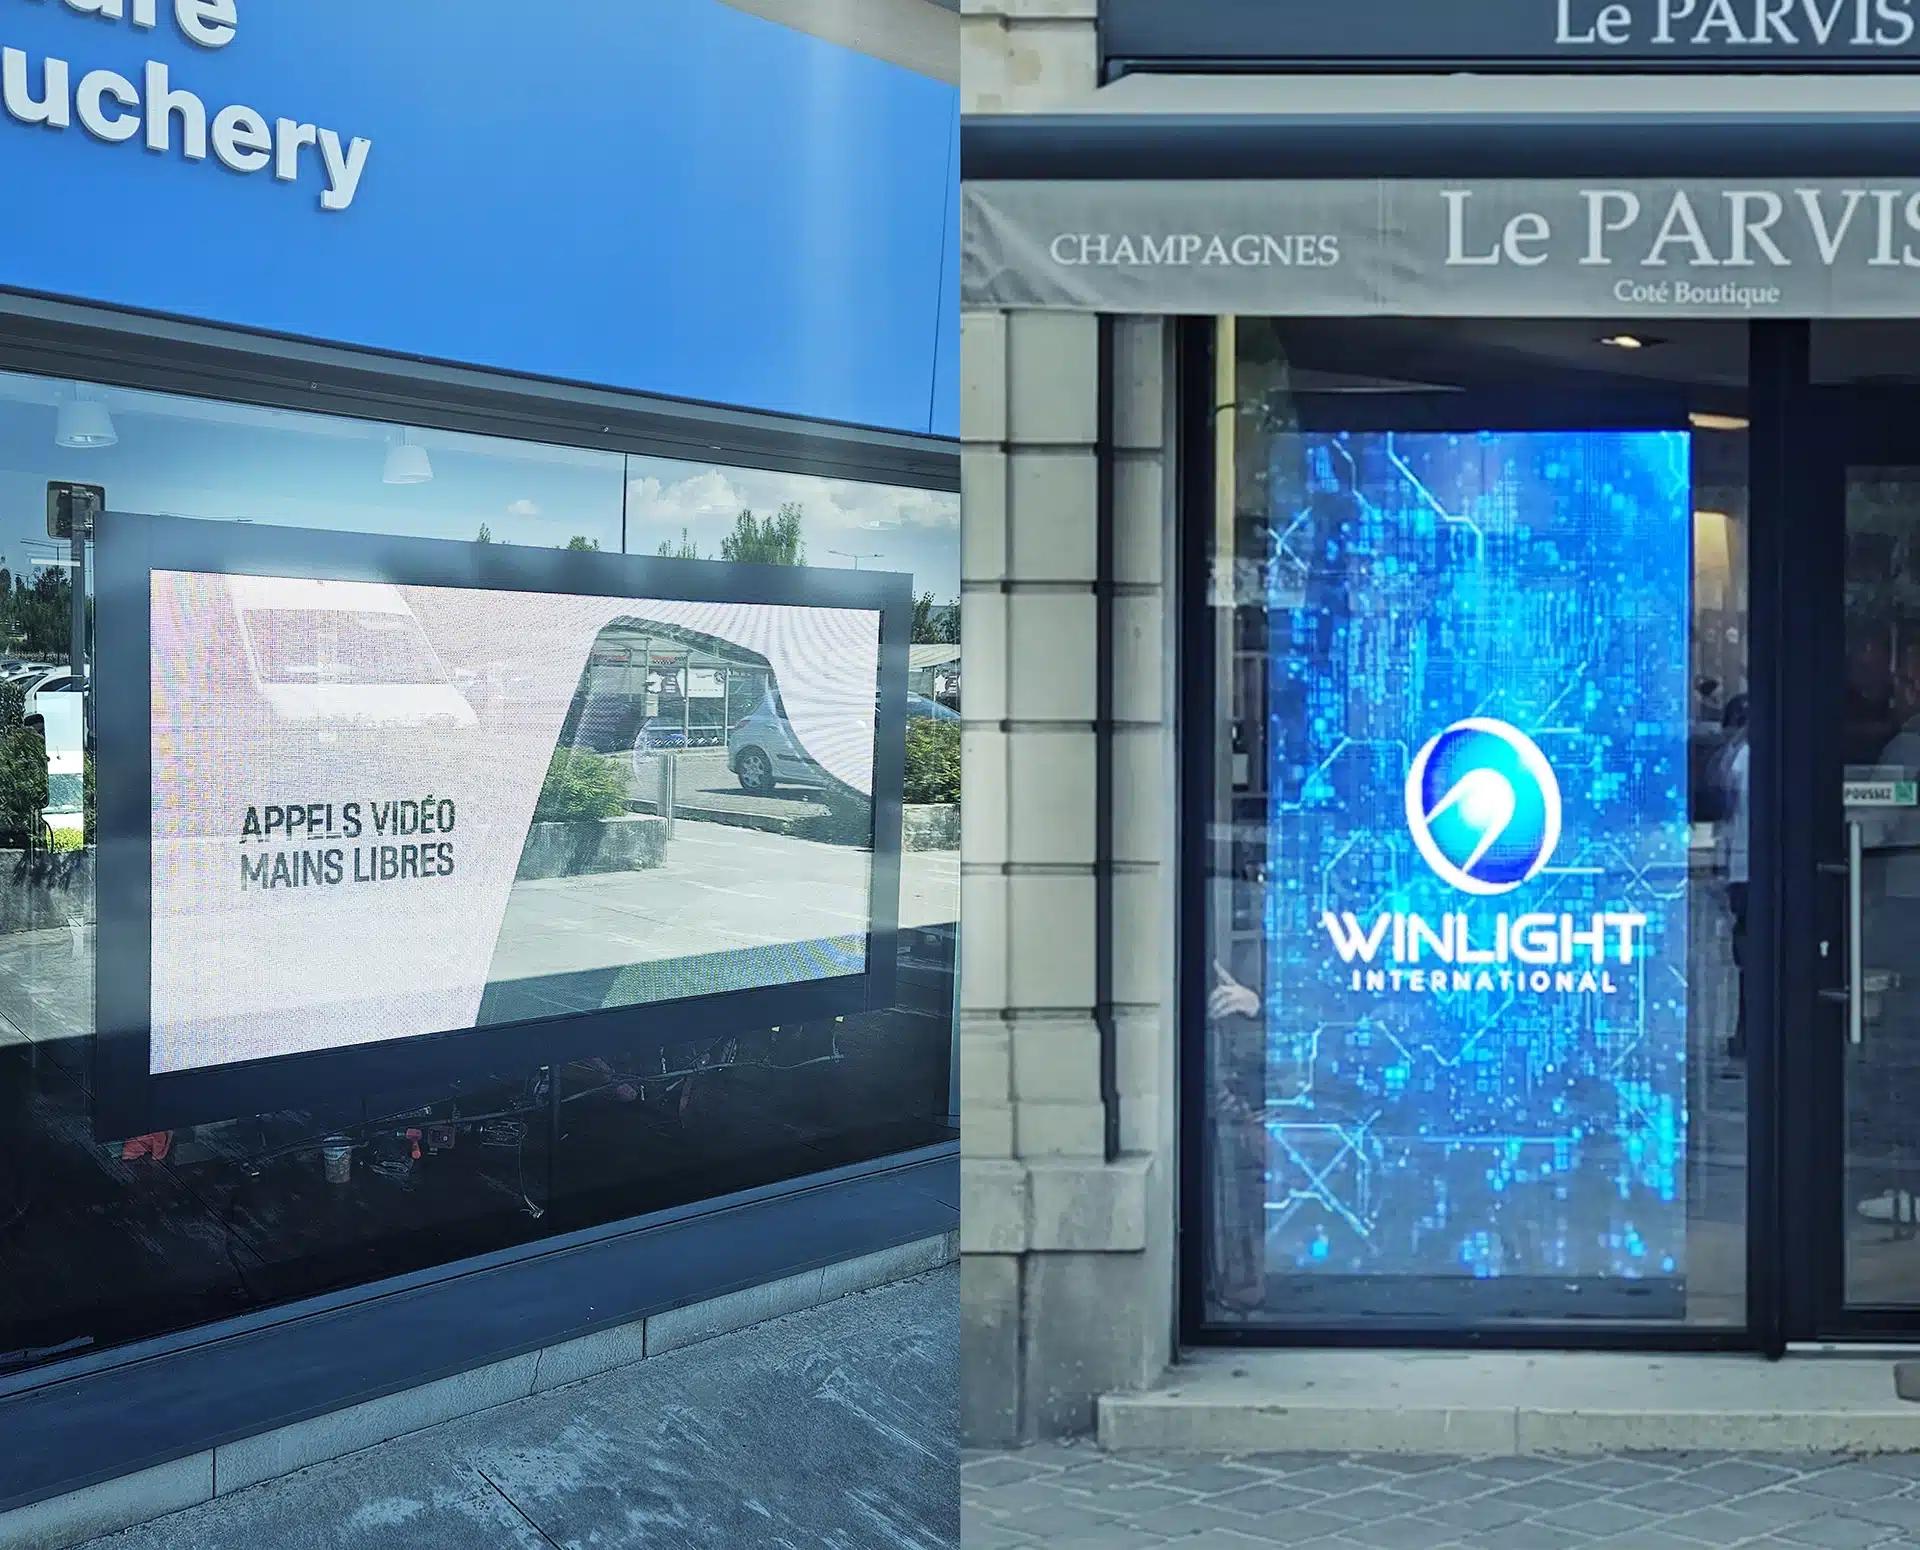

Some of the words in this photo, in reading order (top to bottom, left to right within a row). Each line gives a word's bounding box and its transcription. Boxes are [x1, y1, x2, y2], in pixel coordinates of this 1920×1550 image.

[1555, 0, 1632, 45] Le
[1651, 0, 1915, 46] PARVIS
[2, 46, 371, 210] uchery
[1049, 233, 1341, 267] CHAMPAGNES
[1440, 189, 1551, 266] Le
[1613, 278, 1670, 304] Coté
[1674, 280, 1781, 309] Boutique
[370, 794, 456, 837] VIDÉO
[240, 847, 344, 891] MAINS
[354, 841, 455, 882] LIBRES
[1321, 911, 1648, 965] WINLIGHT
[1352, 969, 1618, 994] INTERNATIONAL
